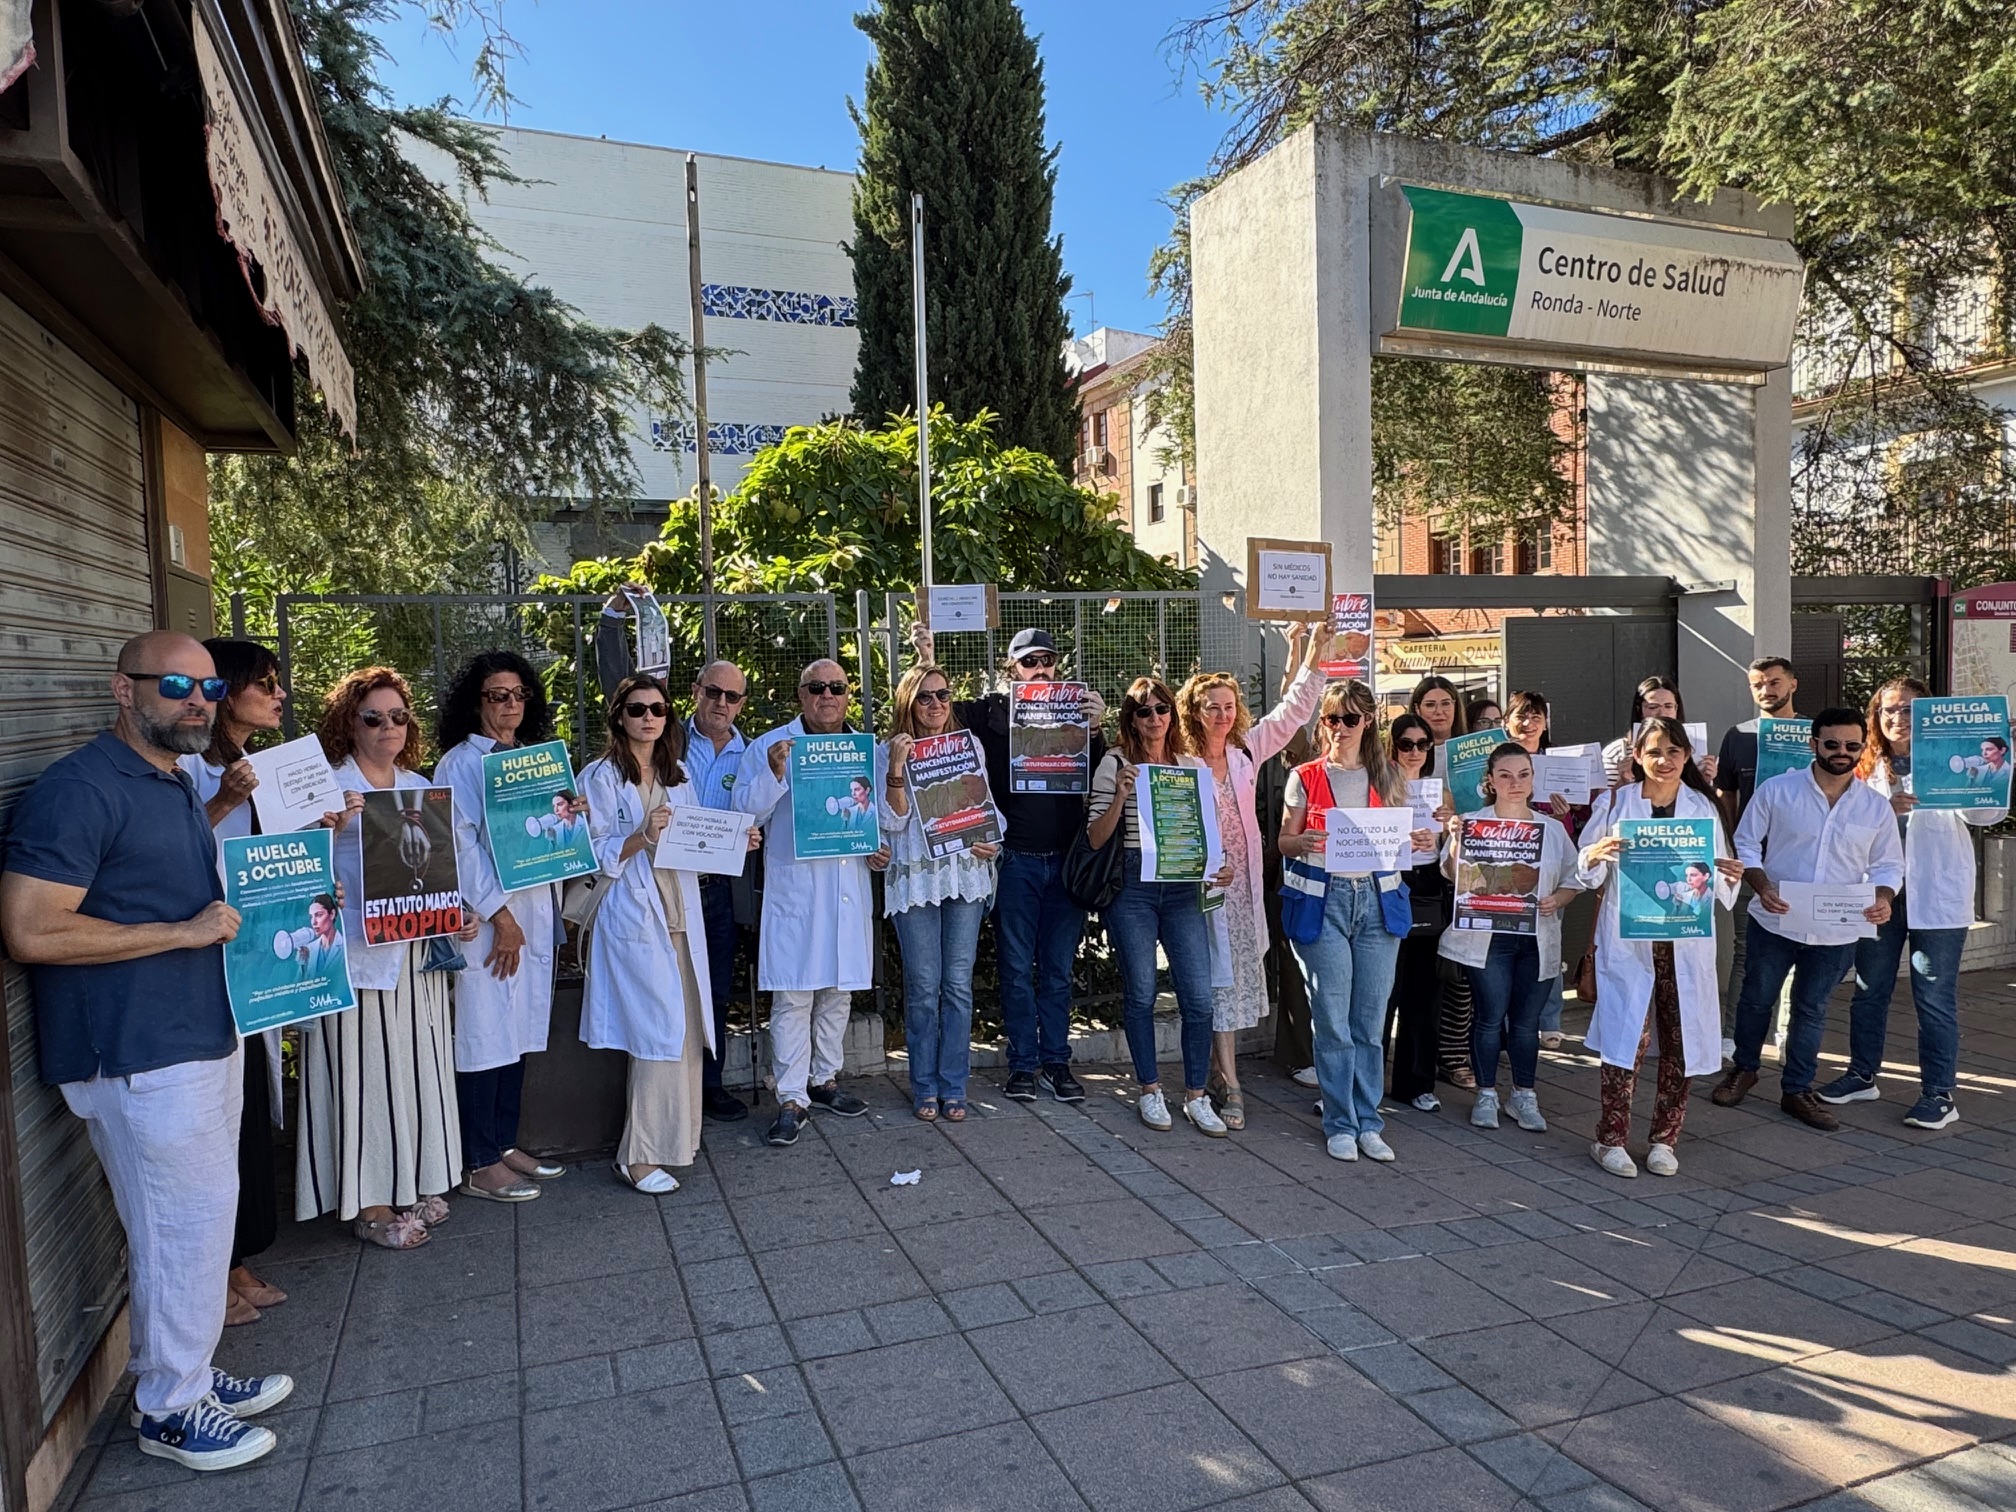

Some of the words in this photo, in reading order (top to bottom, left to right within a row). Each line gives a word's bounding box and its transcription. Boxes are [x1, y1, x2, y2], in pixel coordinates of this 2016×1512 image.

[1538, 247, 1622, 283] Centro
[1628, 258, 1657, 288] de
[1662, 263, 1730, 297] Salud
[1411, 286, 1442, 300] Junta
[1443, 288, 1457, 302] de
[1458, 290, 1508, 307] Andalucía
[1530, 291, 1584, 315] Ronda
[1597, 299, 1642, 321] Norte
[1284, 563, 1311, 571] MÉDICOS
[1954, 603, 1966, 613] CH
[1403, 644, 1447, 653] CAFETERIA
[1015, 684, 1027, 702] 3
[1031, 683, 1084, 702] octubre
[1014, 701, 1080, 710] CONCENTRACIÓ
[1931, 702, 1990, 714] HUELGA
[1017, 710, 1083, 720] MANIFESTACIÓN
[1922, 717, 1930, 727] 3
[1933, 713, 2003, 724] OCTUBRE
[1773, 723, 1812, 735] HUELG
[806, 740, 856, 753] HUELGA
[908, 742, 918, 762] 3
[922, 734, 970, 759] octubre
[1457, 736, 1494, 751] HUELGA
[502, 751, 553, 771] HUELGA
[799, 756, 807, 766] 3
[808, 752, 867, 764] OCTUBRE
[910, 750, 975, 771] CONCENTRACIÓN
[1452, 754, 1458, 763] 3
[494, 776, 502, 788] 3
[505, 762, 566, 784] OCTUBRE
[915, 760, 976, 782] MANIFESTACIÓN
[1160, 768, 1185, 776] HUELGA
[1159, 775, 1194, 783] OCTUBRE
[704, 816, 722, 824] HORAS
[1351, 826, 1382, 834] COTIZO
[1383, 825, 1398, 833] LAS
[1465, 820, 1478, 838] 3
[1481, 820, 1541, 841] octubre
[1636, 825, 1695, 836] HUELGA
[1371, 838, 1387, 846] QUE
[1388, 837, 1400, 845] NO
[1464, 838, 1539, 850] CONCENTRACIÓN
[1628, 839, 1636, 850] 3
[1638, 836, 1707, 848] OCTUBRE
[246, 841, 308, 863] HUELGA
[1356, 850, 1373, 858] CON
[1465, 849, 1535, 860] MANIFESTACIÓN
[237, 870, 249, 887] 3
[251, 857, 323, 881] OCTUBRE
[365, 894, 424, 919] ESTATUTO
[425, 890, 460, 912] MARCO
[364, 907, 462, 944] PROPIO
